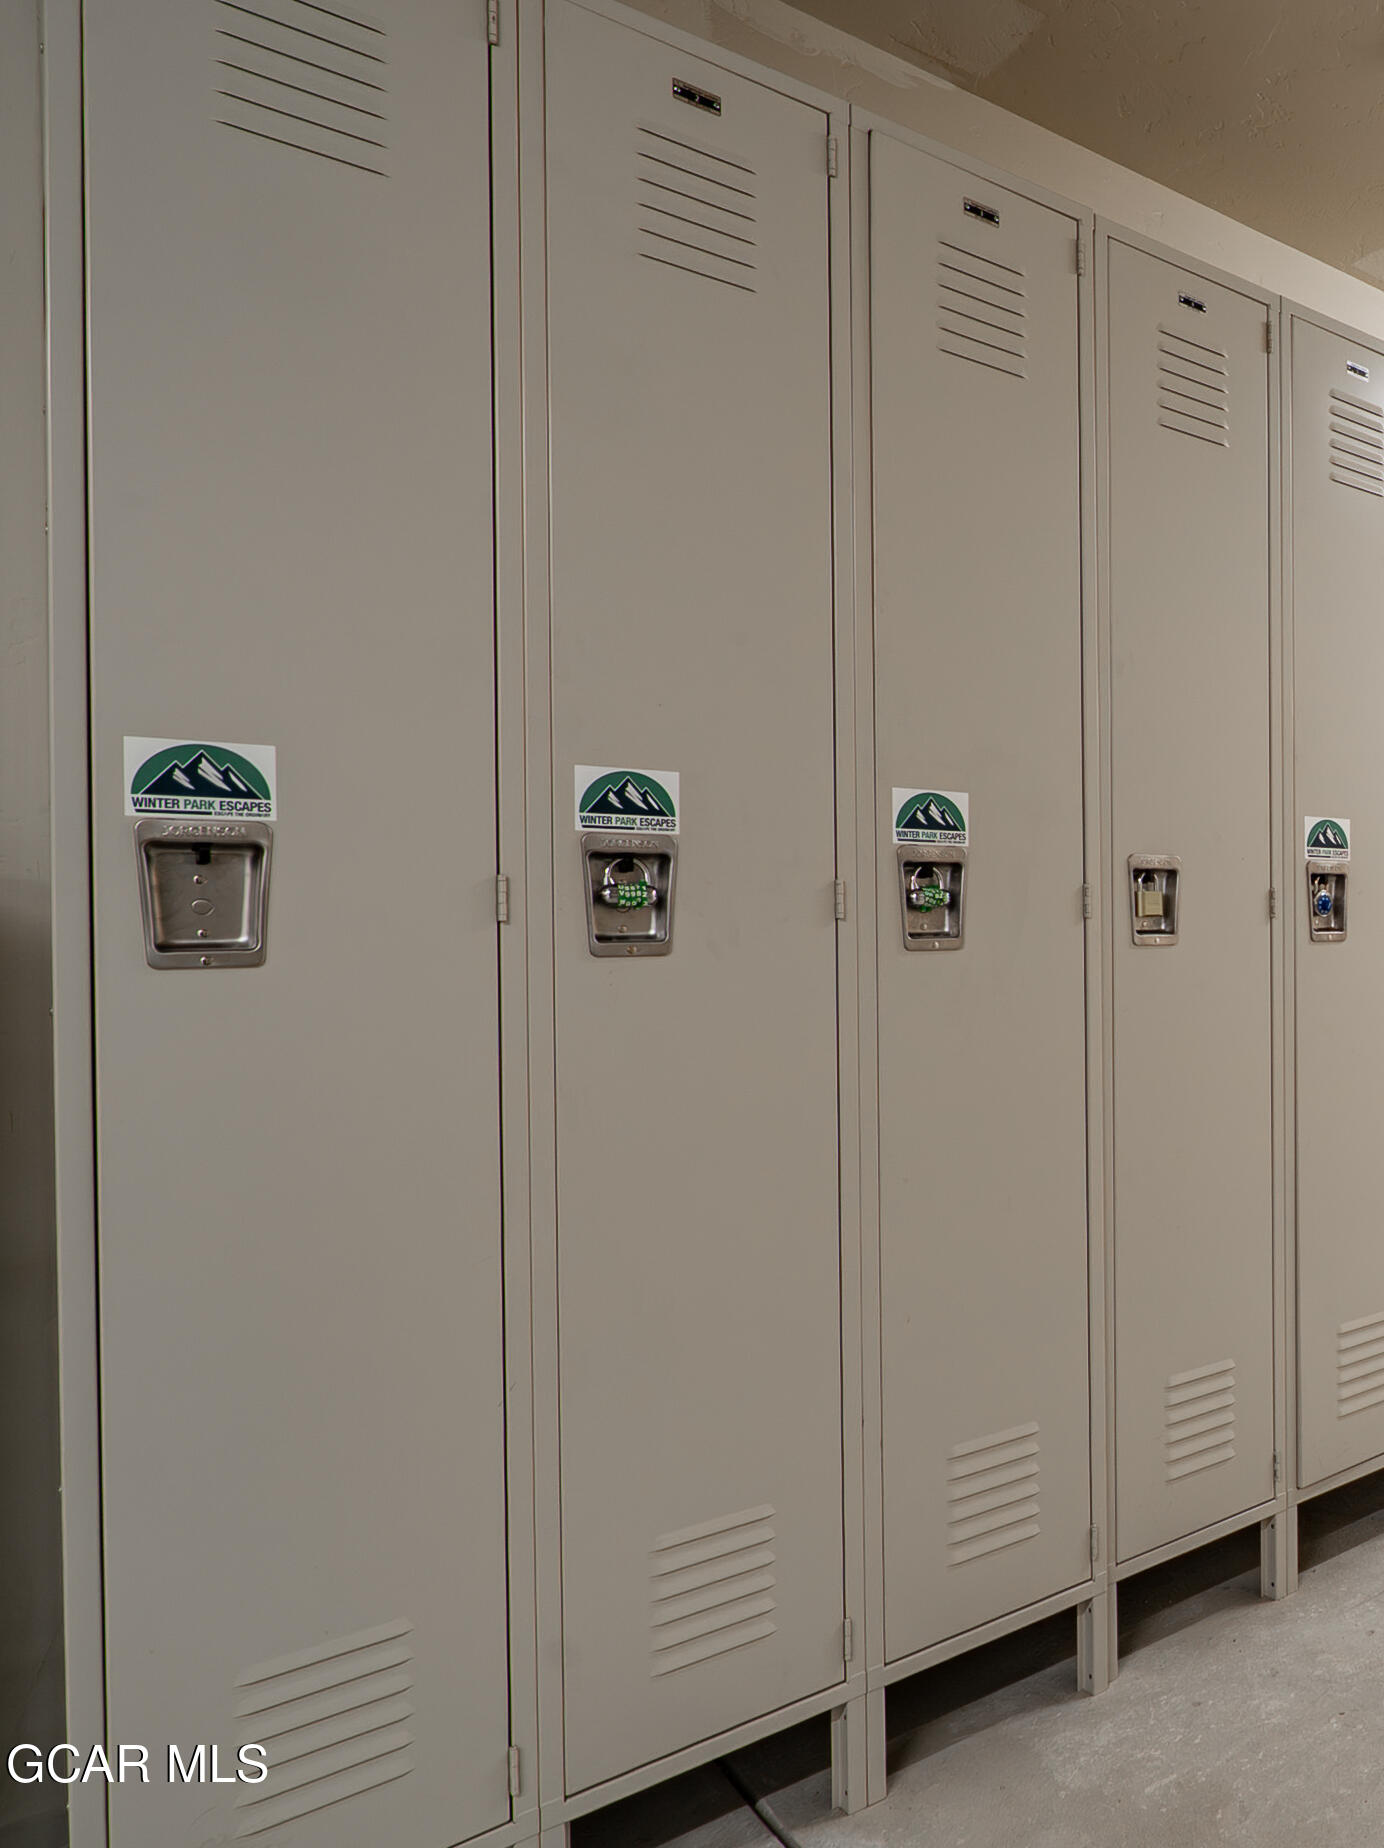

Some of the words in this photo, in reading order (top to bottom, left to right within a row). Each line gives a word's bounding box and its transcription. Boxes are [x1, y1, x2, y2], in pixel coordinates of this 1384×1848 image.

[131, 795, 180, 810] WINTER
[184, 798, 217, 811] PARK
[219, 800, 272, 813] ESCAPES
[579, 814, 613, 826] WINTER
[615, 816, 637, 826] PARK
[639, 817, 677, 828] ESCAPES
[895, 829, 921, 839] WINTER
[922, 831, 938, 840] PARK
[939, 832, 967, 841] ESCAPES
